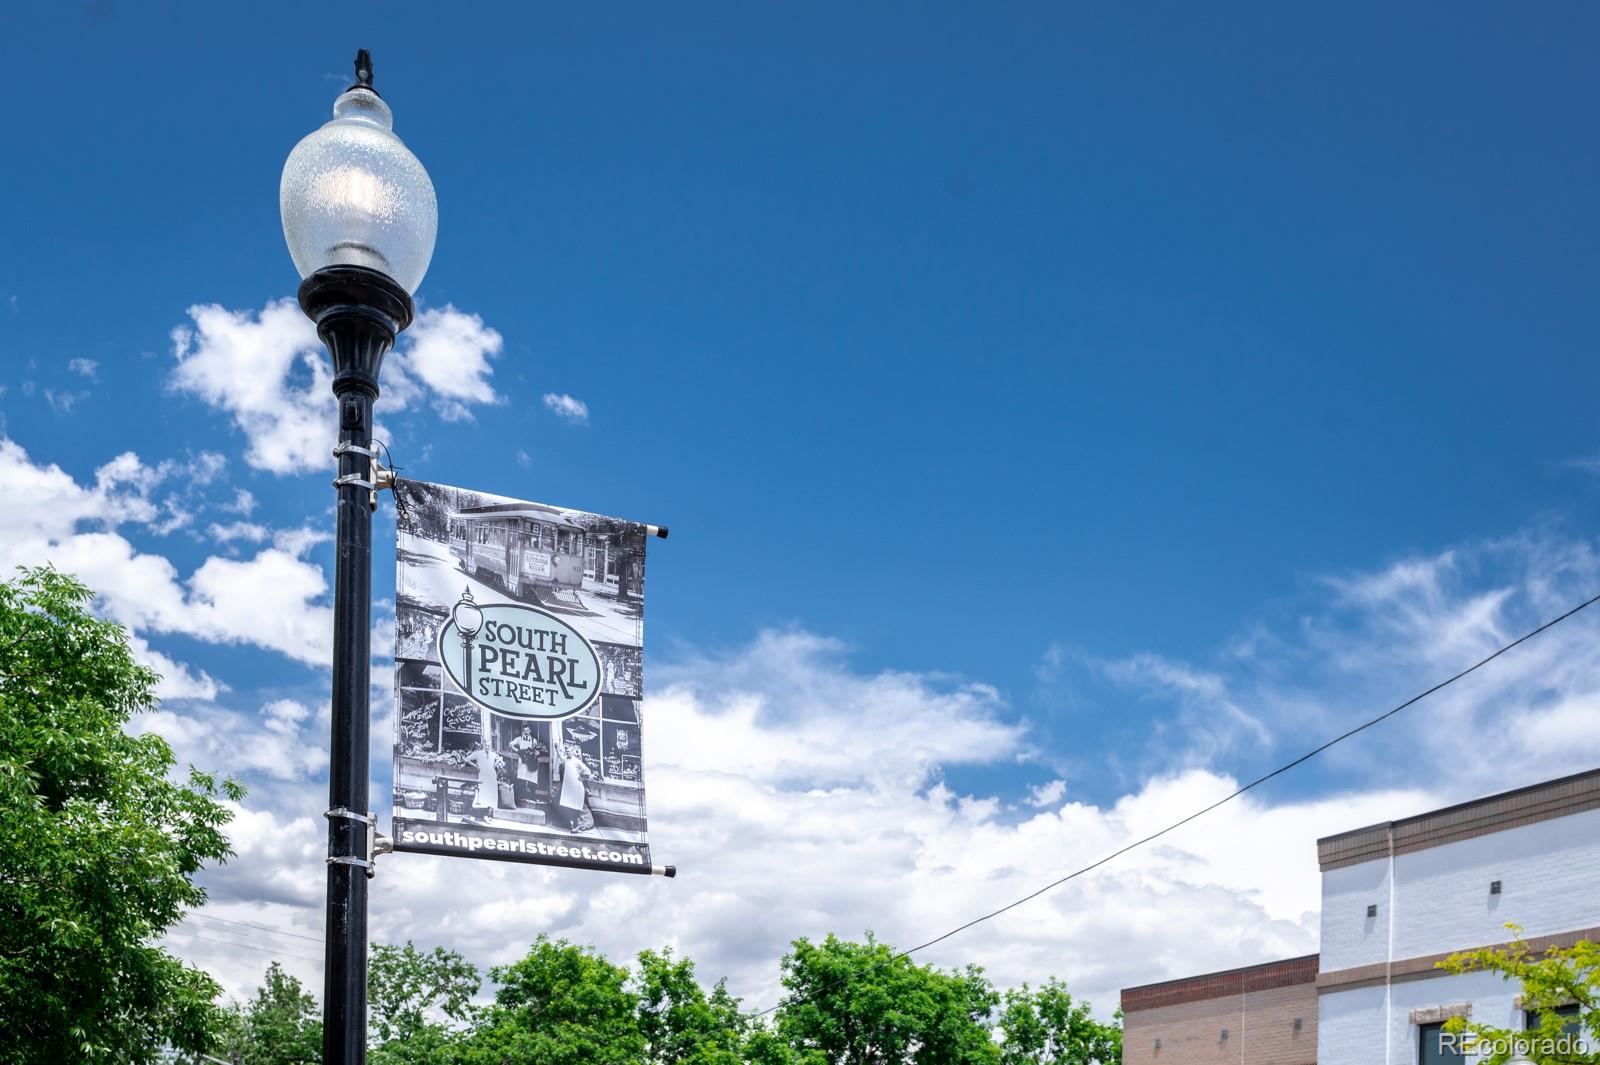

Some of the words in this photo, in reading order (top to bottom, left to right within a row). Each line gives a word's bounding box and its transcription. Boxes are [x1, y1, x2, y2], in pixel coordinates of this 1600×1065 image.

[485, 620, 567, 655] SOUTH
[478, 644, 587, 699] PEARL
[479, 677, 558, 706] STREET
[402, 830, 643, 864] southpearlstreet.com
